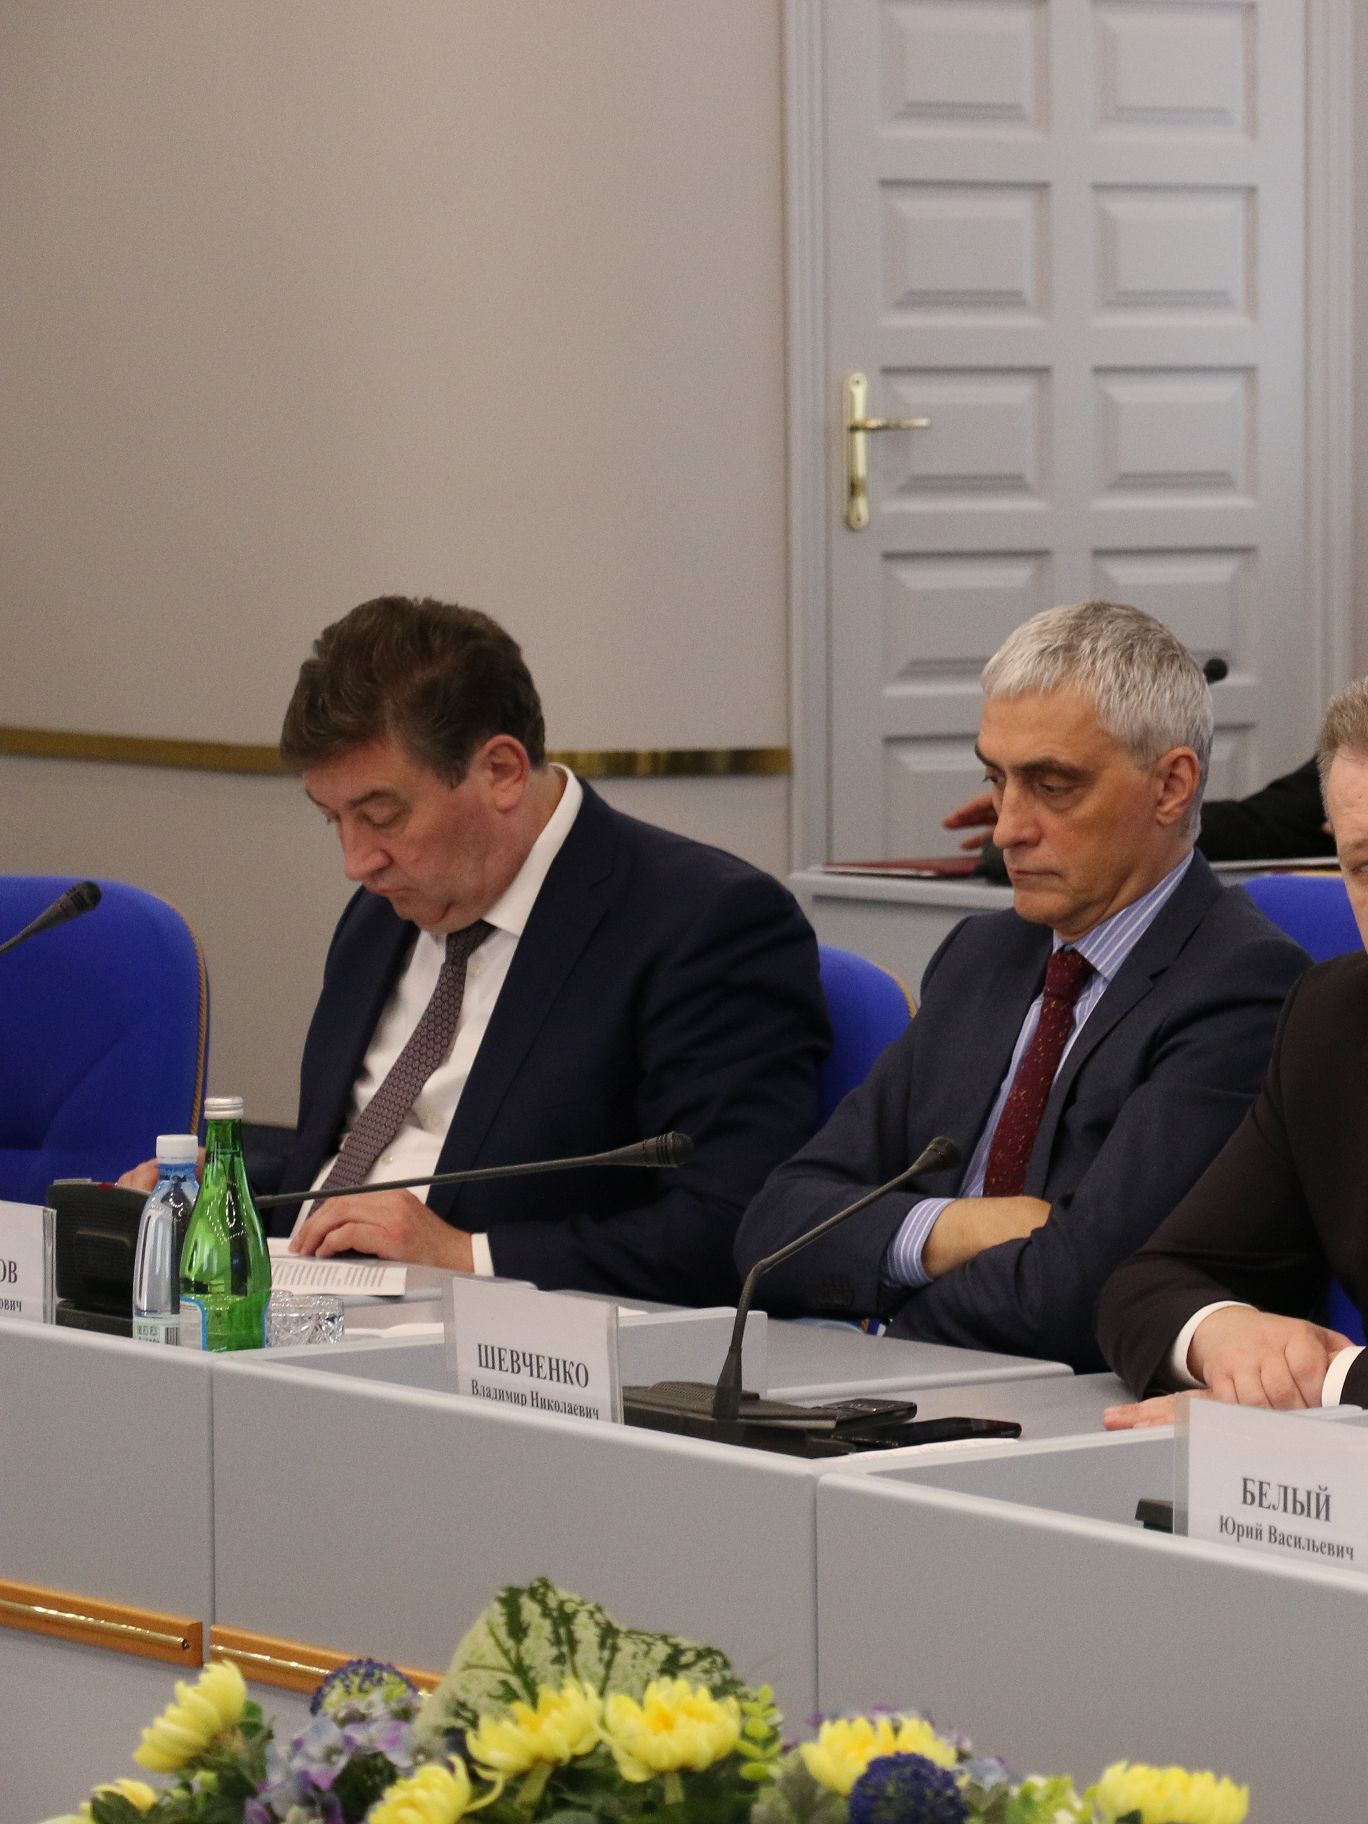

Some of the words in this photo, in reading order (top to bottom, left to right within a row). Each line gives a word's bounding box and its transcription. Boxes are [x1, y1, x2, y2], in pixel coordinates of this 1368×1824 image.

[477, 1343, 590, 1389] ШЕВЧЕНКО
[471, 1378, 528, 1407] Владимир
[530, 1390, 600, 1421] Николаевич
[1241, 1476, 1333, 1523] БЕЛЫЙ
[1218, 1514, 1264, 1543] Юрий
[1268, 1524, 1355, 1561] Васильевич
